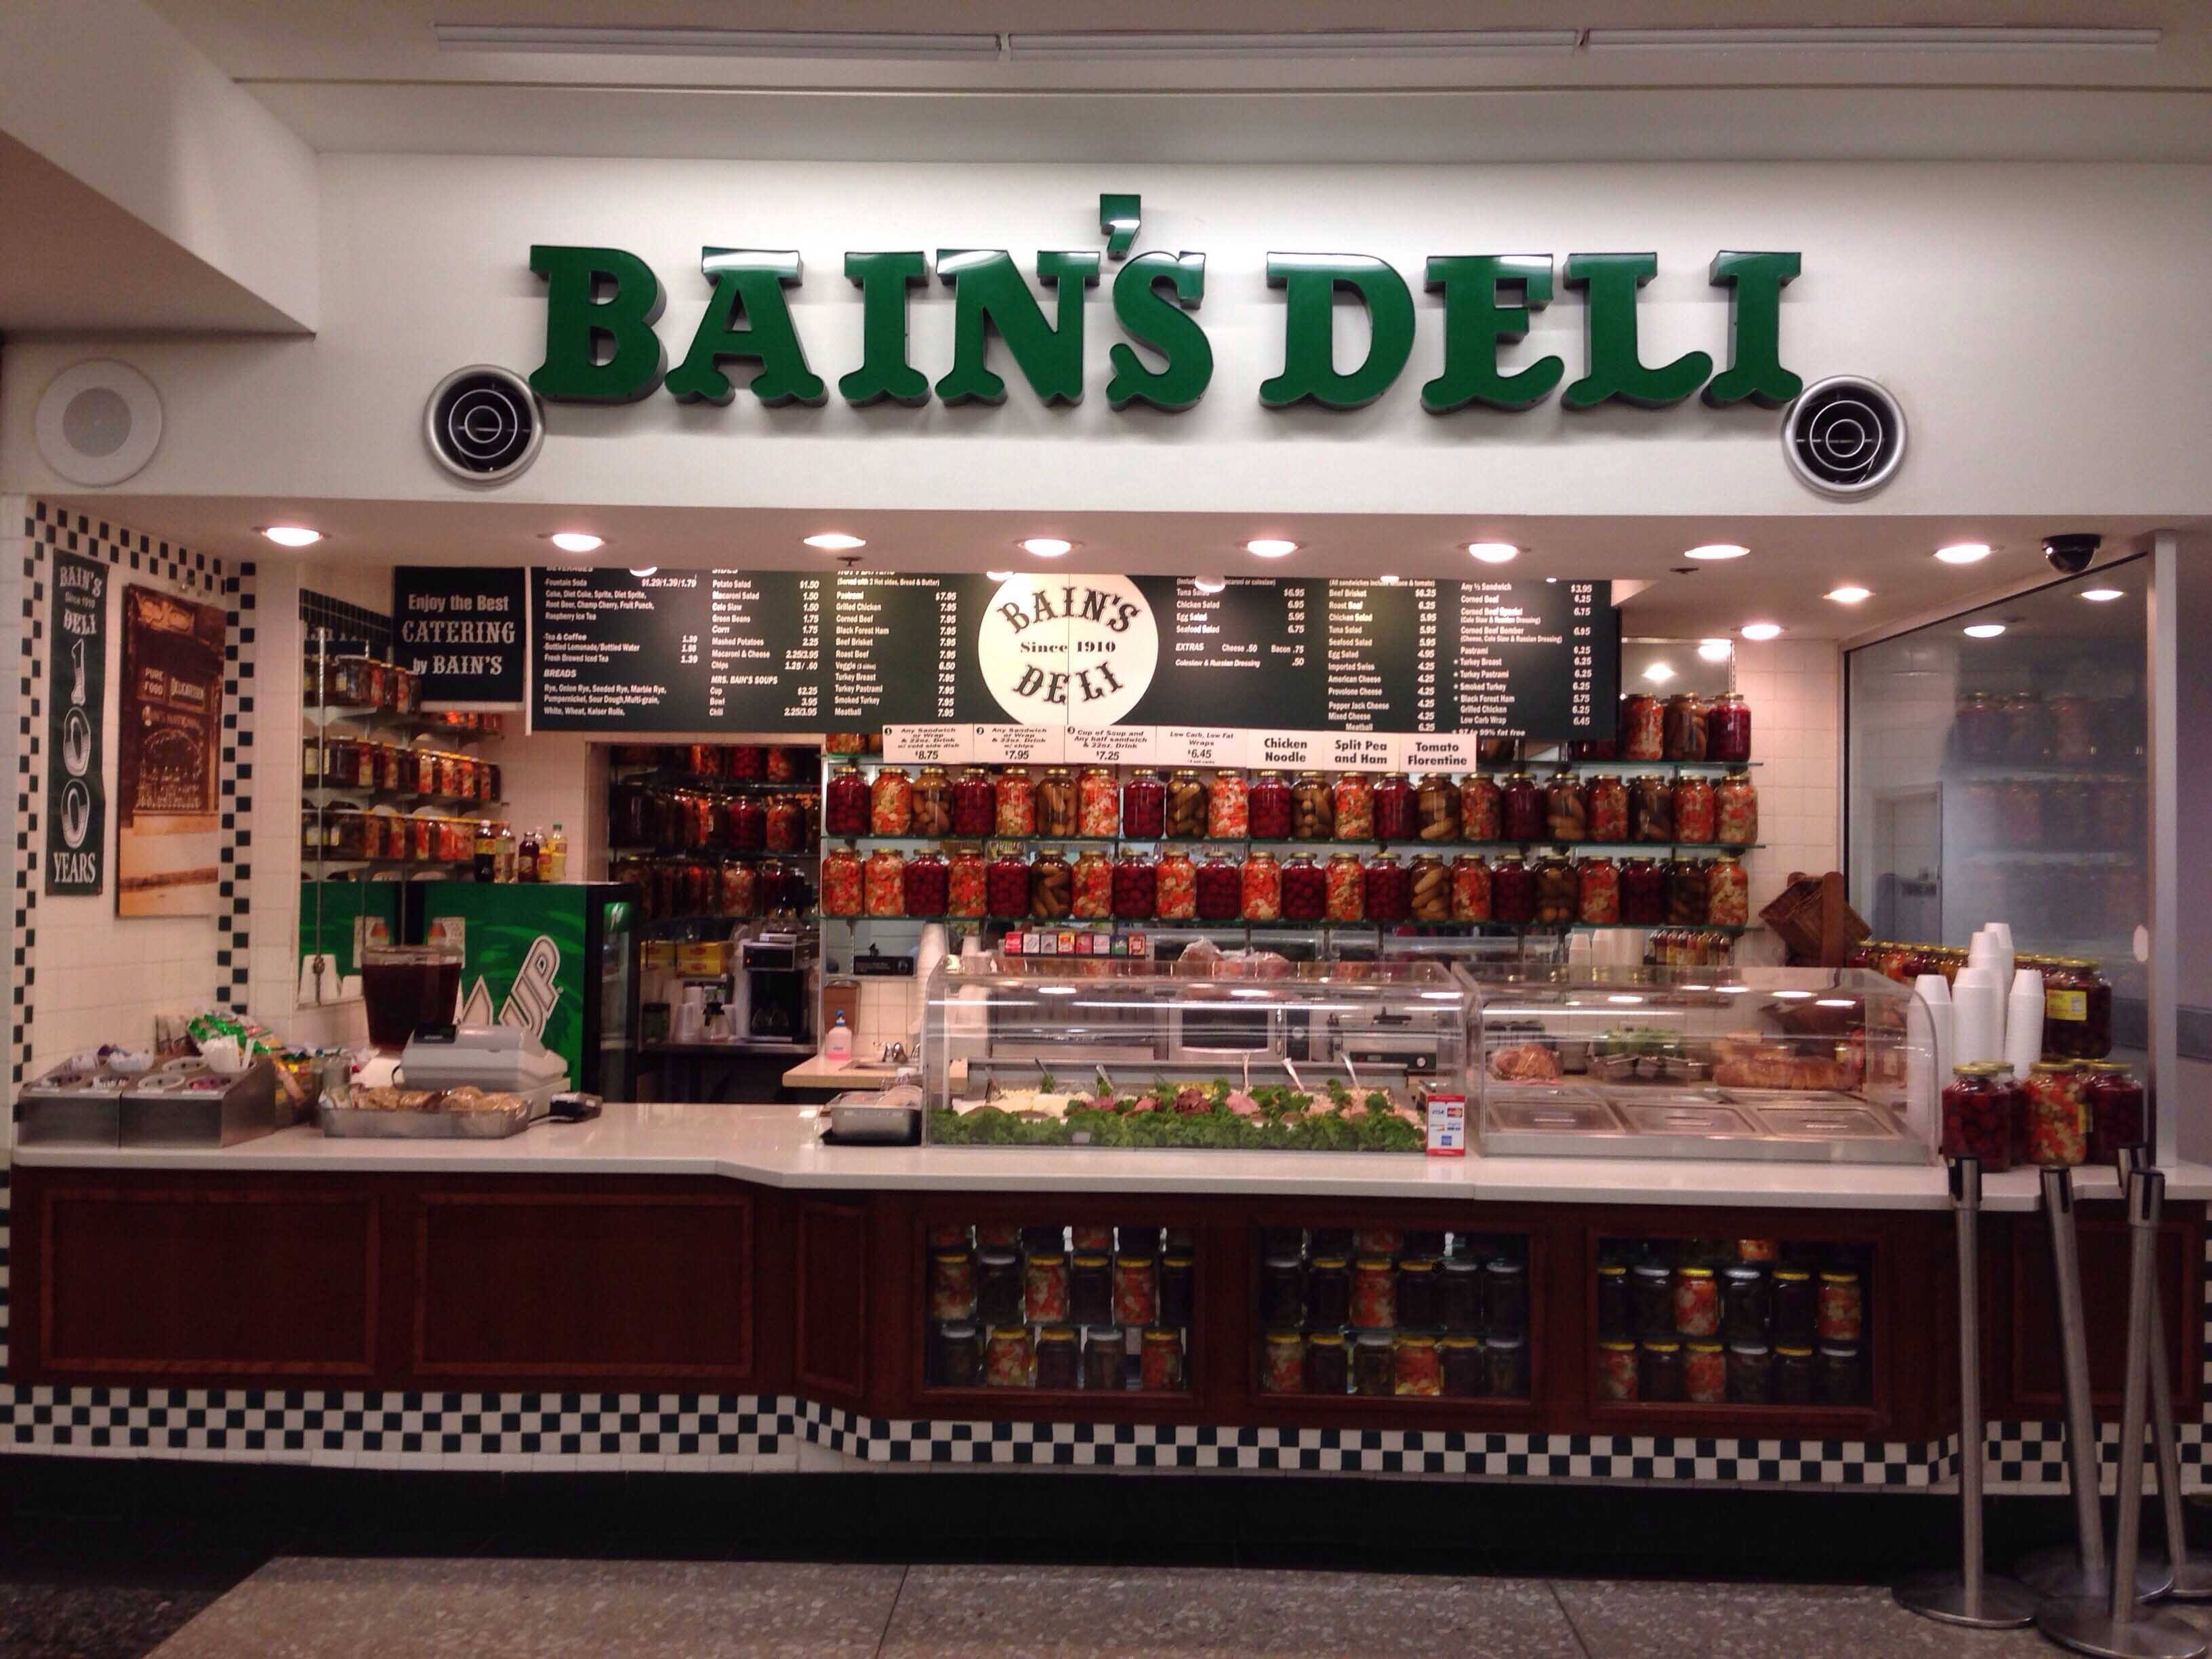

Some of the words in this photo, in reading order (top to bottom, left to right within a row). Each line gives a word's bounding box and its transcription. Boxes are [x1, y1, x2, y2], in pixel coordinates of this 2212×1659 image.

[529, 194, 1214, 409] BAIN'S
[1258, 251, 1803, 411] DELI
[60, 565, 102, 597] BAIN'S
[713, 580, 733, 588] Potato
[409, 594, 445, 613] Enjoy
[450, 594, 472, 611] the
[476, 595, 509, 611] Best
[997, 586, 1142, 634] BAIN'S
[63, 609, 97, 635] DELI
[803, 615, 819, 623] 1.75
[401, 620, 515, 644] CATERING
[712, 626, 730, 634] Corn
[802, 626, 818, 634] 1.75
[836, 626, 853, 634] Black
[855, 626, 874, 634] Forest
[1021, 641, 1067, 653] Since
[1077, 641, 1116, 653] 1910
[1175, 643, 1204, 651] EXTRAS
[1222, 644, 1244, 653] Cheese
[1271, 644, 1290, 653] Bacon
[836, 650, 853, 658] Roast
[413, 657, 428, 675] by
[432, 655, 502, 676] BAIN'S
[544, 669, 576, 678] BREADS
[835, 673, 855, 682] Turkey
[144, 681, 163, 695] FOOD
[1011, 661, 1123, 705] DELI
[710, 687, 722, 695] Cup
[710, 697, 725, 705] Bowl
[834, 696, 859, 704] Smoked
[860, 696, 880, 705] Turkey
[1264, 739, 1307, 749] Chicken
[1335, 740, 1361, 752] Split
[1366, 741, 1387, 751] Pea
[1416, 743, 1459, 752] Tomato
[915, 750, 939, 760] $8.75
[1005, 750, 1029, 760] $7.95
[1096, 751, 1120, 760] $7.25
[1187, 750, 1212, 758] $6.45
[1265, 752, 1306, 762] Noodle
[1334, 754, 1356, 764] and
[1361, 754, 1387, 764] Ham
[1408, 755, 1467, 766] Florentine
[53, 851, 96, 884] YEARS
